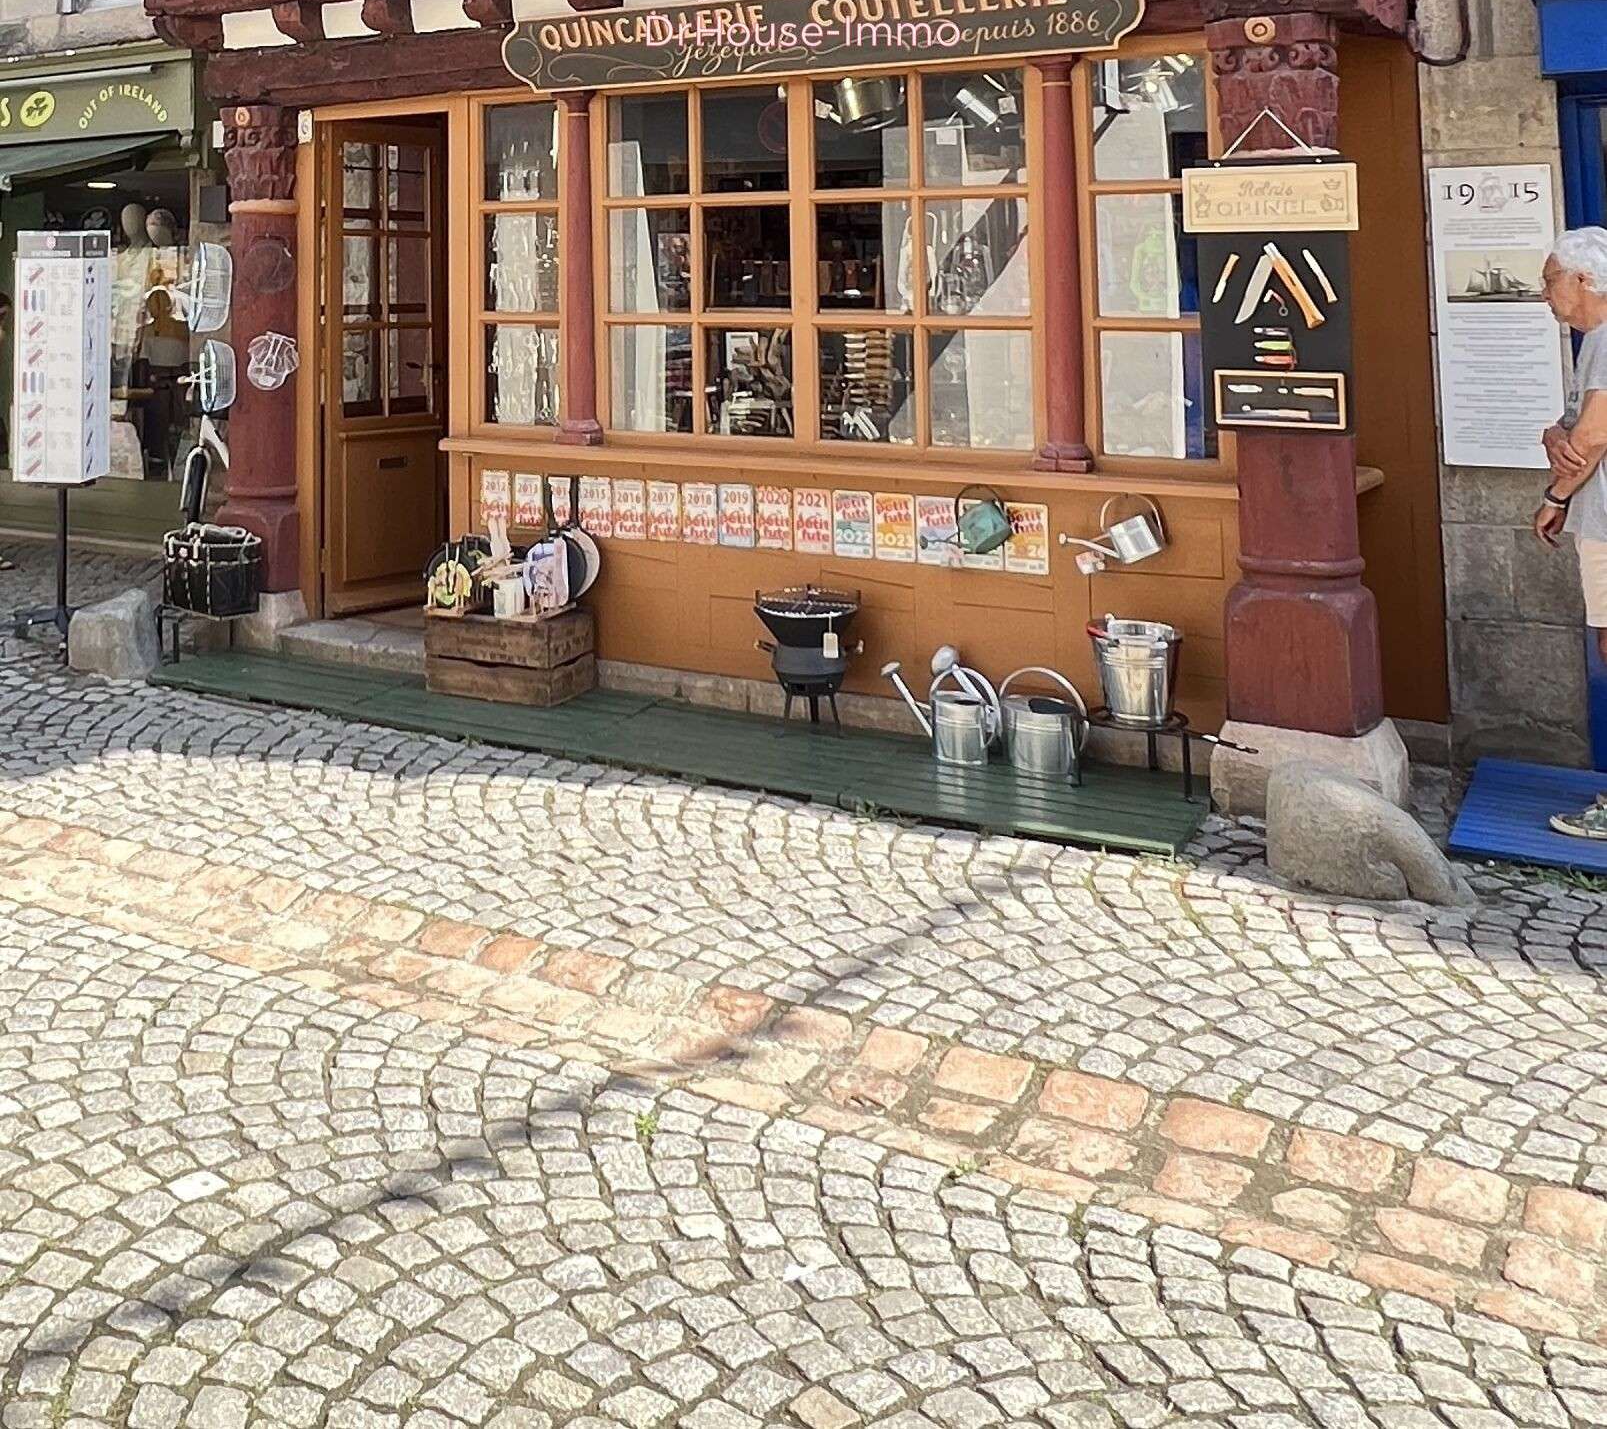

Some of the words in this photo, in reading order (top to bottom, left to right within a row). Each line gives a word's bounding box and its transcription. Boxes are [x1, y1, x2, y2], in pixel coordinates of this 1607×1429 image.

[1046, 9, 1100, 36] 1886
[78, 99, 98, 130] OUT
[99, 84, 115, 102] OF
[119, 84, 169, 123] IRELAND
[1216, 199, 1317, 217] OPINEL
[617, 491, 641, 504] 2016
[651, 491, 675, 503] 2017
[688, 493, 712, 505] 2018
[724, 490, 749, 504] 2019
[760, 491, 789, 505] 2020
[798, 492, 828, 507] 2021
[836, 528, 871, 544] 2022
